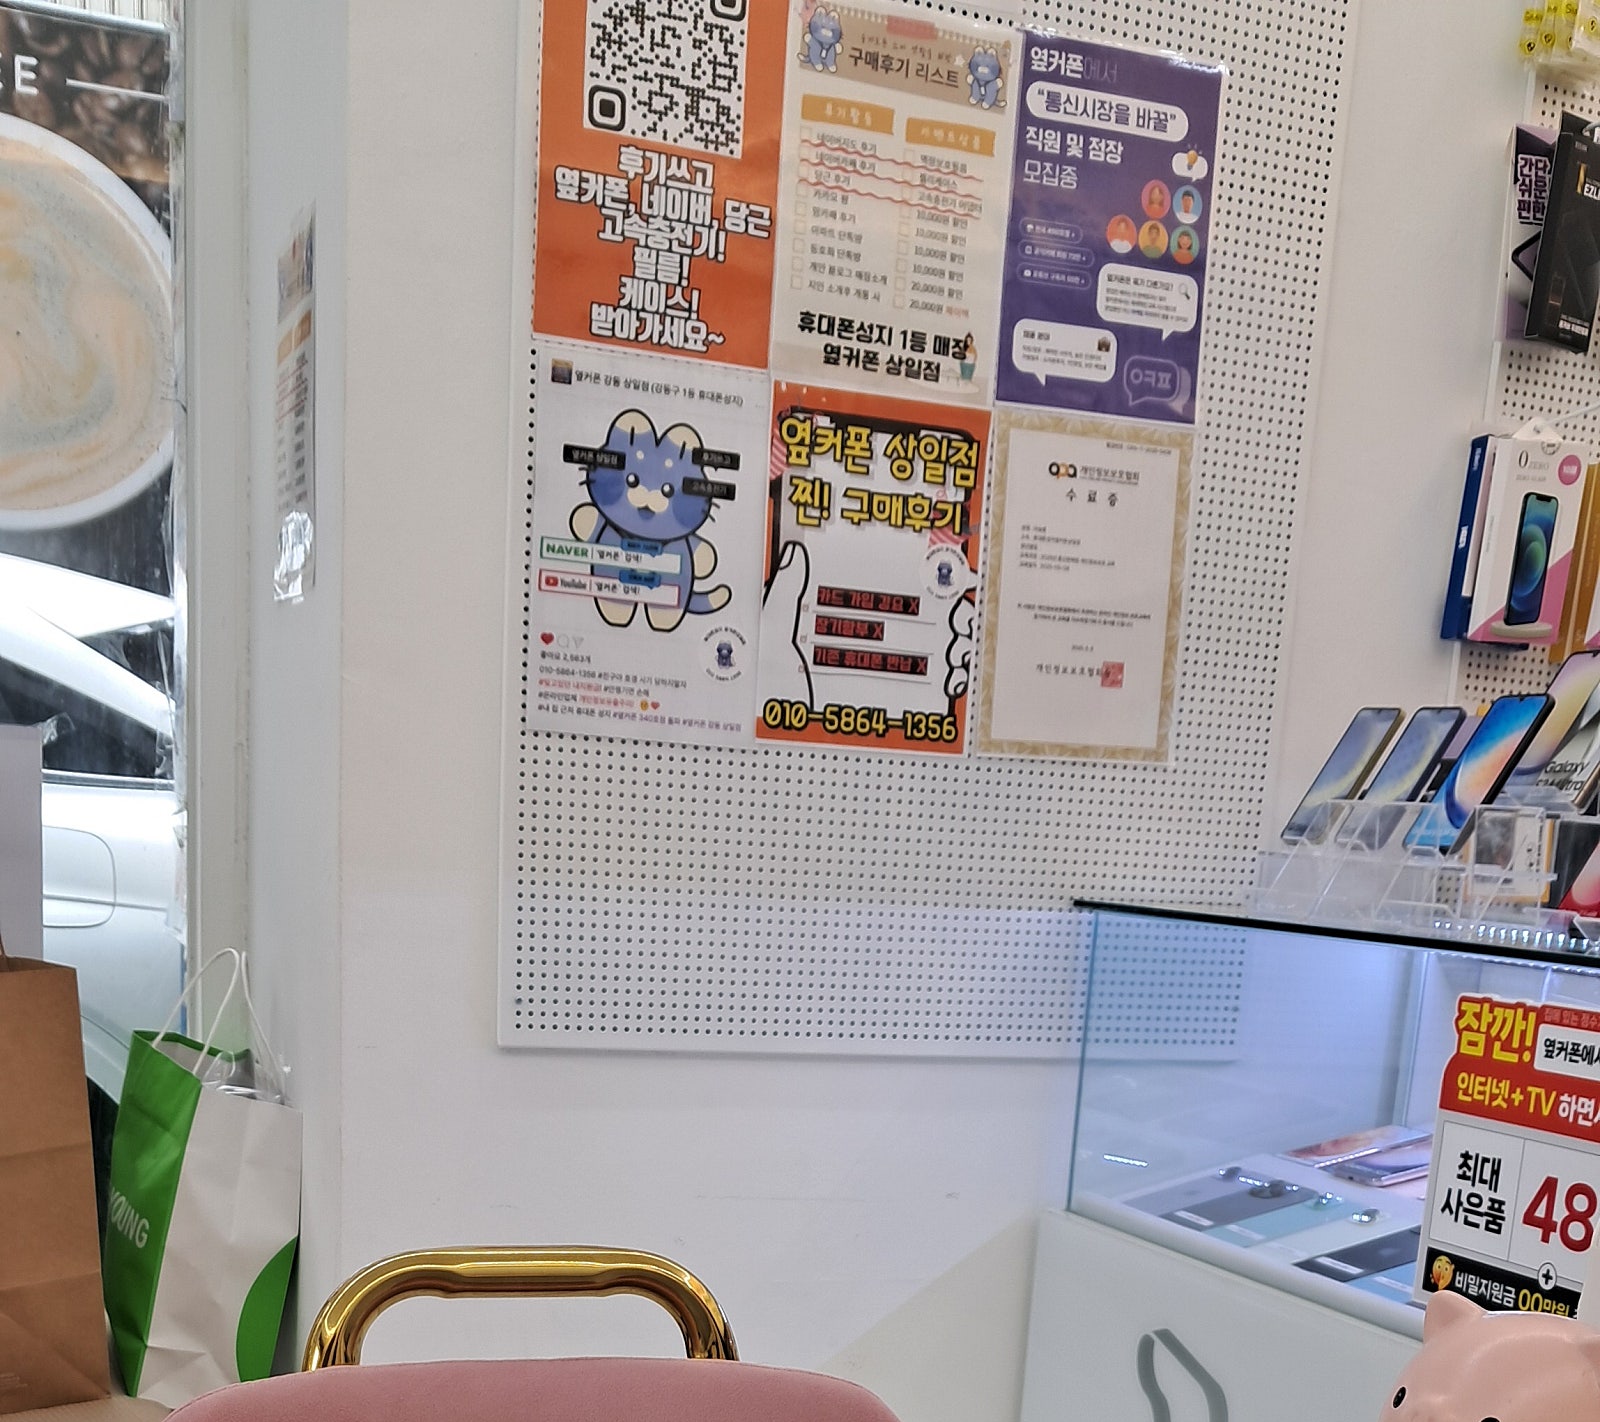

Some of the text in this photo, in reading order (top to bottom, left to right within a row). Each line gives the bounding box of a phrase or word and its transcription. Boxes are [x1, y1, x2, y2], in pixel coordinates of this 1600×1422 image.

[848, 47, 910, 79] 구매후기
[915, 63, 959, 88] 리스트
[1030, 46, 1118, 83] 옆커폰에서
[1025, 126, 1124, 165] 직원 및 점장
[618, 144, 715, 194] 후기쓰고
[1023, 159, 1078, 190] 모집중
[1519, 156, 1551, 179] 간단
[555, 164, 636, 216] 옆커폰,
[724, 198, 772, 239] 당근
[1518, 178, 1548, 200] 쉬운
[597, 207, 727, 262] 고속충전기!
[632, 247, 690, 287] 필름!
[618, 274, 701, 320] 케이스!
[590, 302, 725, 353] 받아가세요~
[797, 310, 968, 361] 휴대폰성지 1등 매장
[822, 343, 941, 383] 옆커폰 상일점
[575, 370, 601, 385] 옆커폰
[603, 374, 621, 388] 강동
[623, 377, 650, 392] 상일점
[683, 387, 695, 399] 1등
[780, 417, 980, 488] 옆커폰 상일점
[789, 476, 963, 535] 찐! 구매후기
[546, 543, 589, 558] NAVER
[819, 588, 918, 613] 카드 가입 강요 X
[816, 618, 882, 638] 장기할부 X
[815, 648, 927, 673] 기존 휴대폰 반납 X
[765, 700, 956, 740] 010-5864-1356
[1545, 760, 1590, 776] Galaxy
[1458, 1001, 1537, 1063] 잠깐!
[1581, 1012, 1600, 1029] 정수
[1456, 1150, 1502, 1193] 최대
[1440, 1187, 1506, 1235] 사은품
[1522, 1175, 1598, 1252] 48
[1455, 1271, 1516, 1307] 비밀지원금
